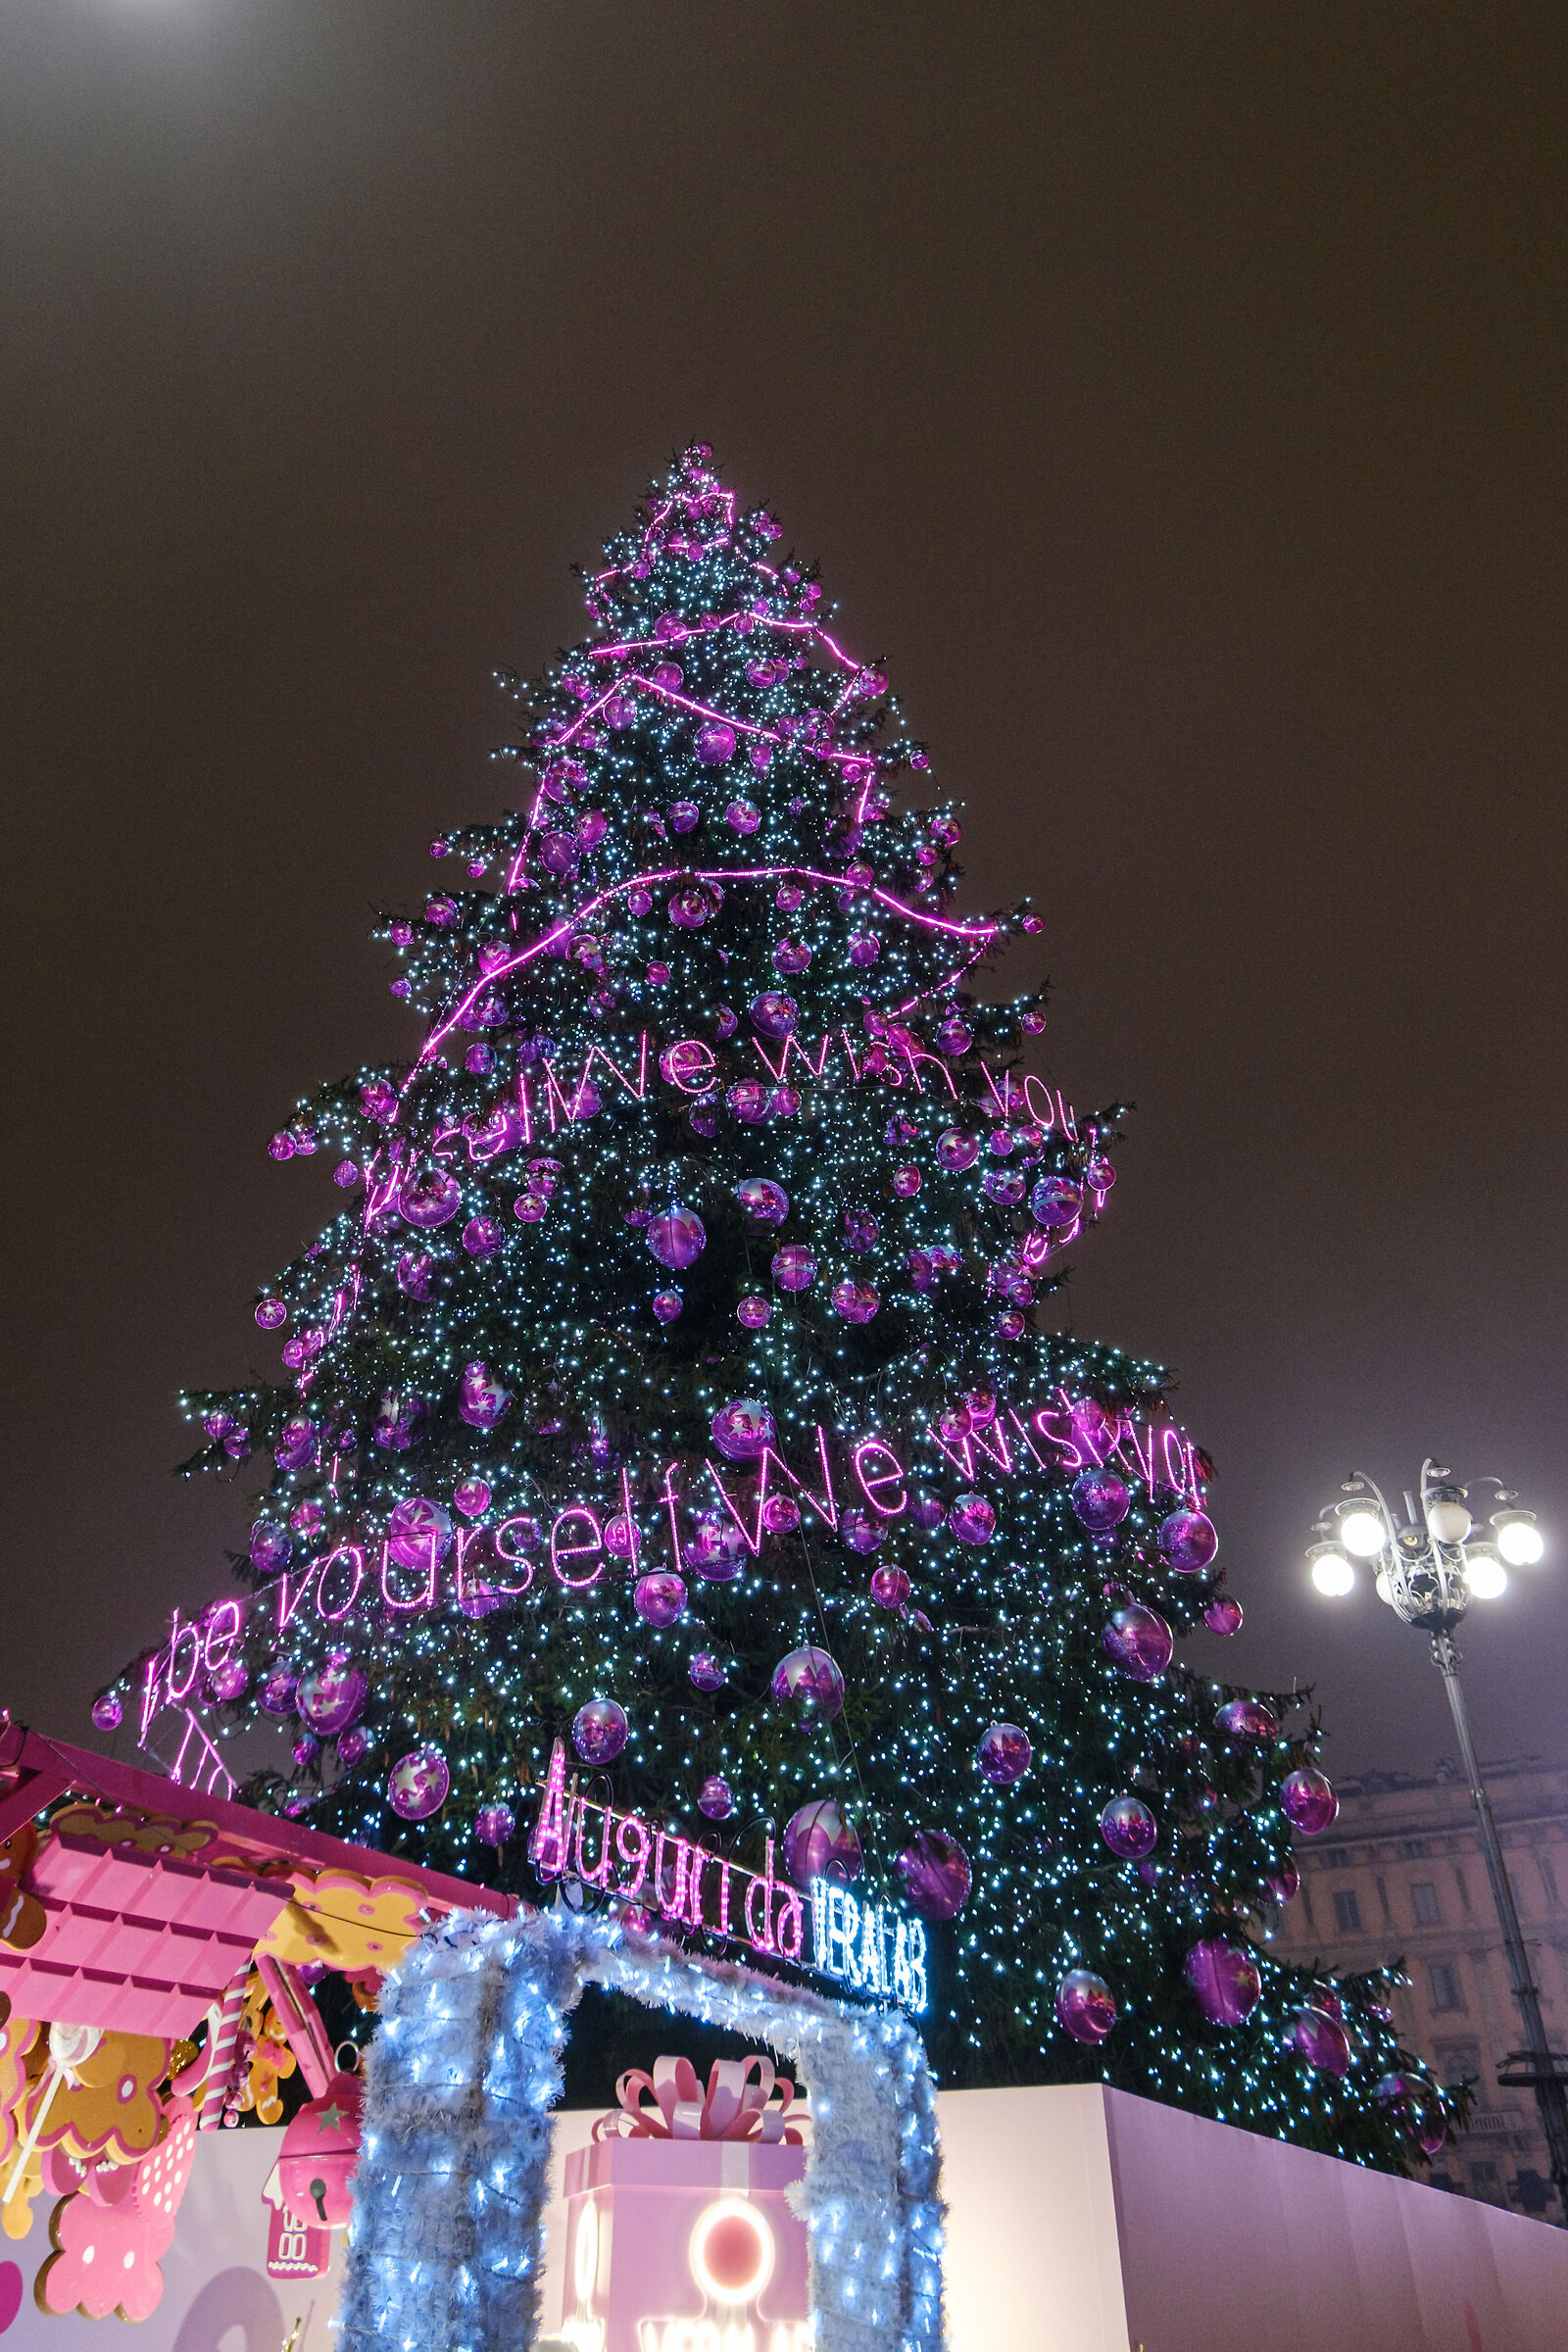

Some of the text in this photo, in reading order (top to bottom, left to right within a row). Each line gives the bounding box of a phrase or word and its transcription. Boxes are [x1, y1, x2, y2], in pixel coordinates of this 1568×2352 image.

[541, 1030, 716, 1125] We
[751, 1028, 958, 1101] wish
[980, 1060, 1079, 1144] you
[270, 1462, 684, 1652] yourself
[704, 1424, 908, 1558] We
[536, 1738, 731, 1937] Auguri
[745, 1836, 805, 1960] da
